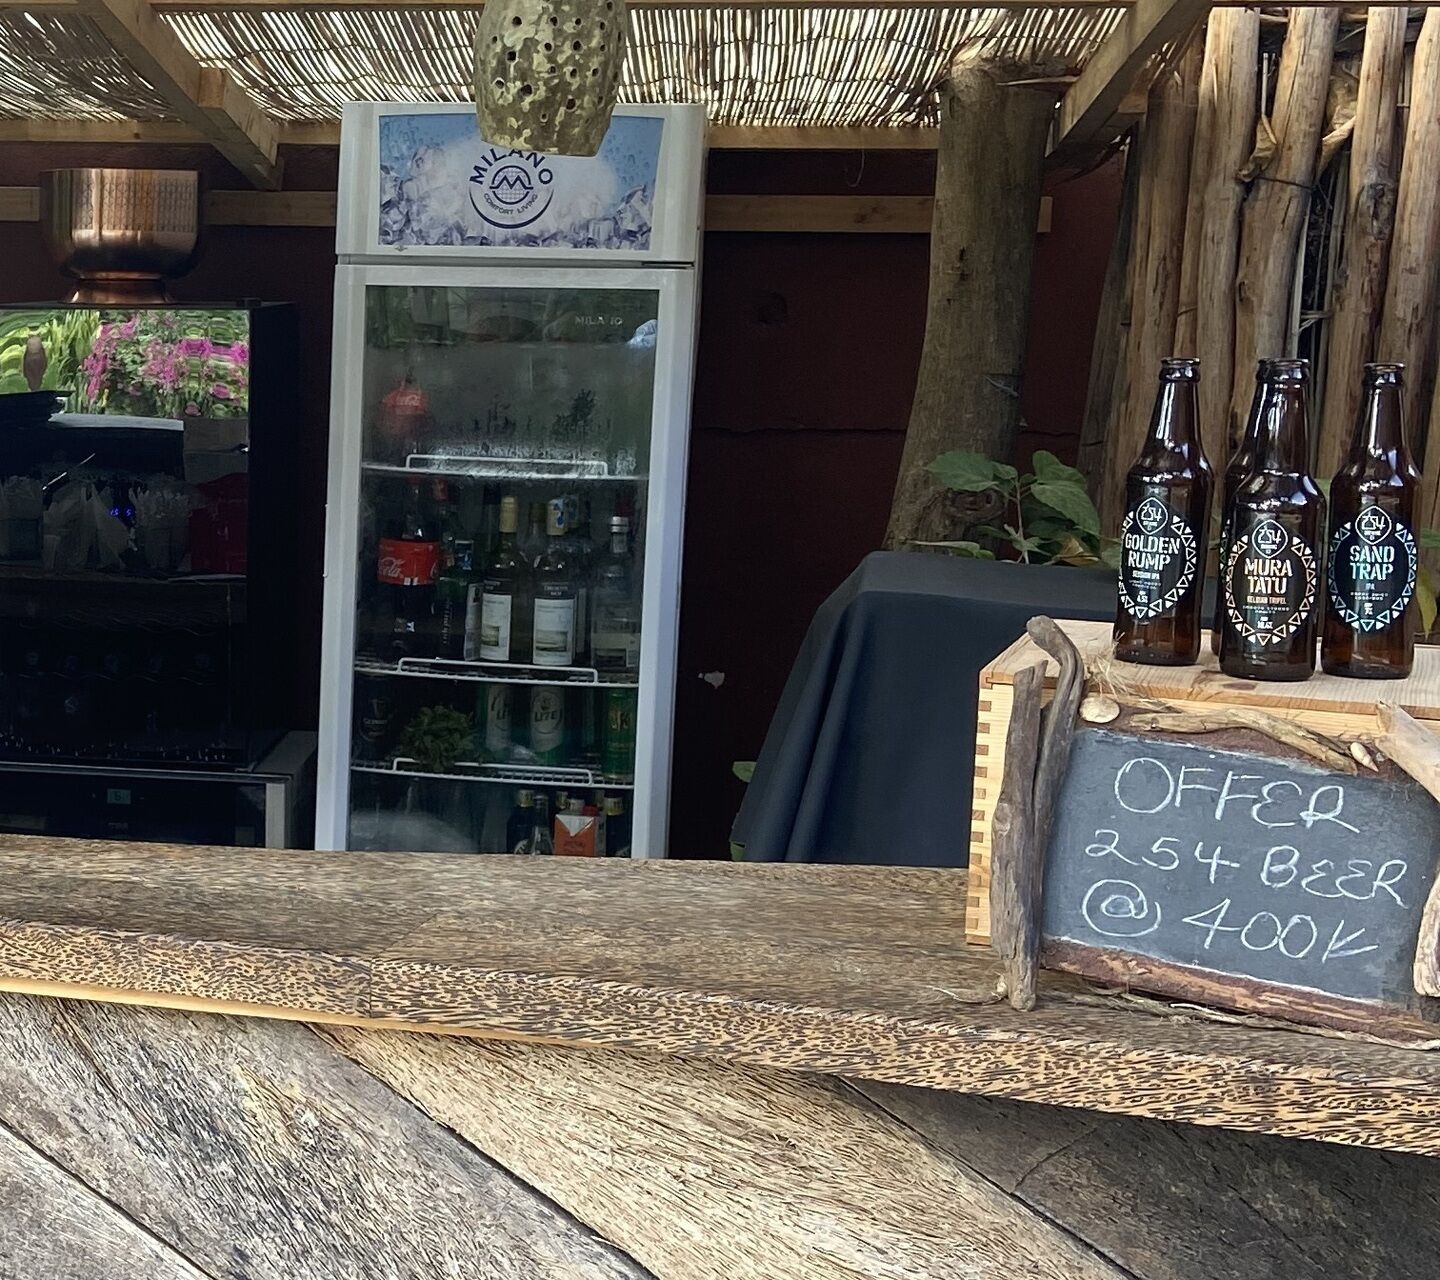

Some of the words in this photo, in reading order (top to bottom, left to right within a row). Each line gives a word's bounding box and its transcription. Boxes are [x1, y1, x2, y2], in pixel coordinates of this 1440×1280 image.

[469, 148, 553, 185] MILANO
[1141, 503, 1162, 521] 254
[1361, 511, 1385, 530] 254
[1125, 533, 1180, 554] GOLDEN
[1258, 526, 1281, 544] 254
[1128, 551, 1171, 570] RUMP
[1349, 545, 1395, 563] SAND
[1244, 558, 1293, 577] MURA
[1349, 562, 1394, 580] TRAP
[1247, 576, 1287, 594] TATU
[1114, 757, 1360, 834] OFFER
[1085, 829, 1241, 884] 254
[1260, 844, 1409, 910] BEER
[1082, 878, 1162, 938] @
[1181, 898, 1380, 964] 400K
